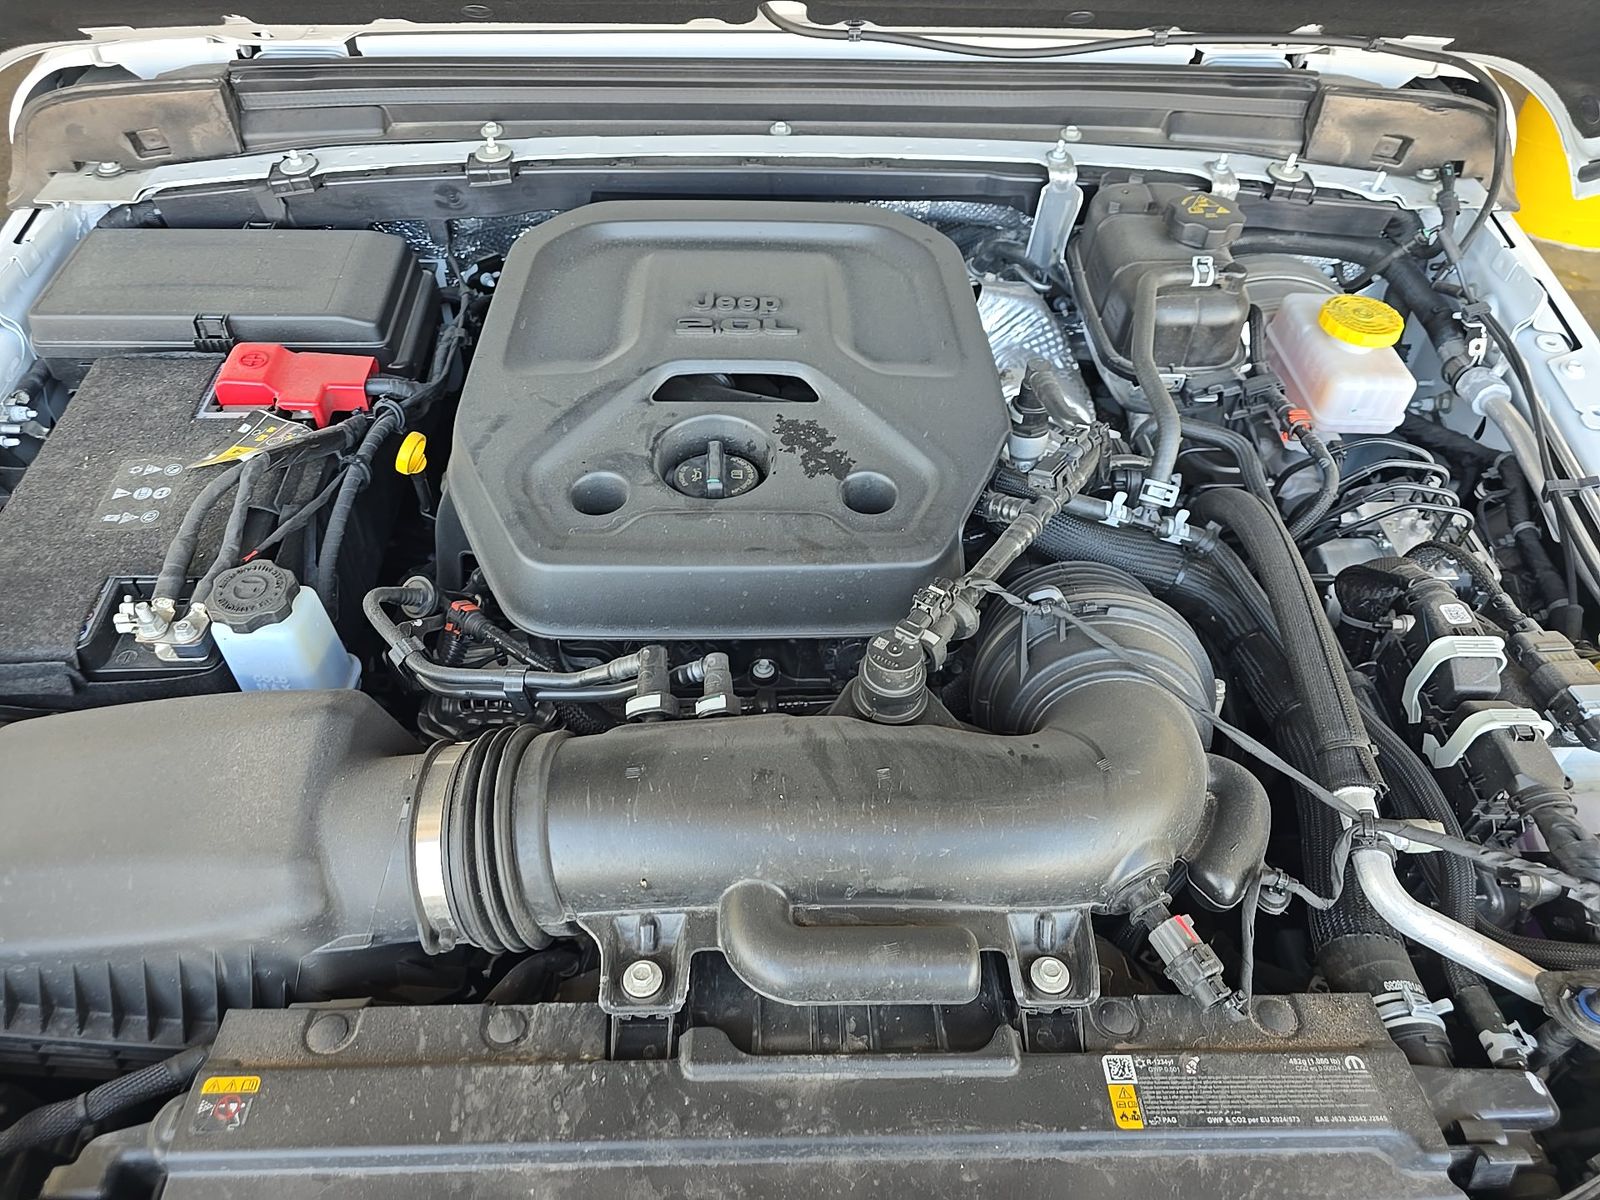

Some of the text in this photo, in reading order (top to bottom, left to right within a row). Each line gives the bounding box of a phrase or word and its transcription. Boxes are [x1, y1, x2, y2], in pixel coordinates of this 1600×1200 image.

[691, 291, 782, 315] Jeep
[675, 316, 800, 336] 2.0L
[1231, 1116, 1247, 1124] CO2
[1259, 1116, 1271, 1124] EU
